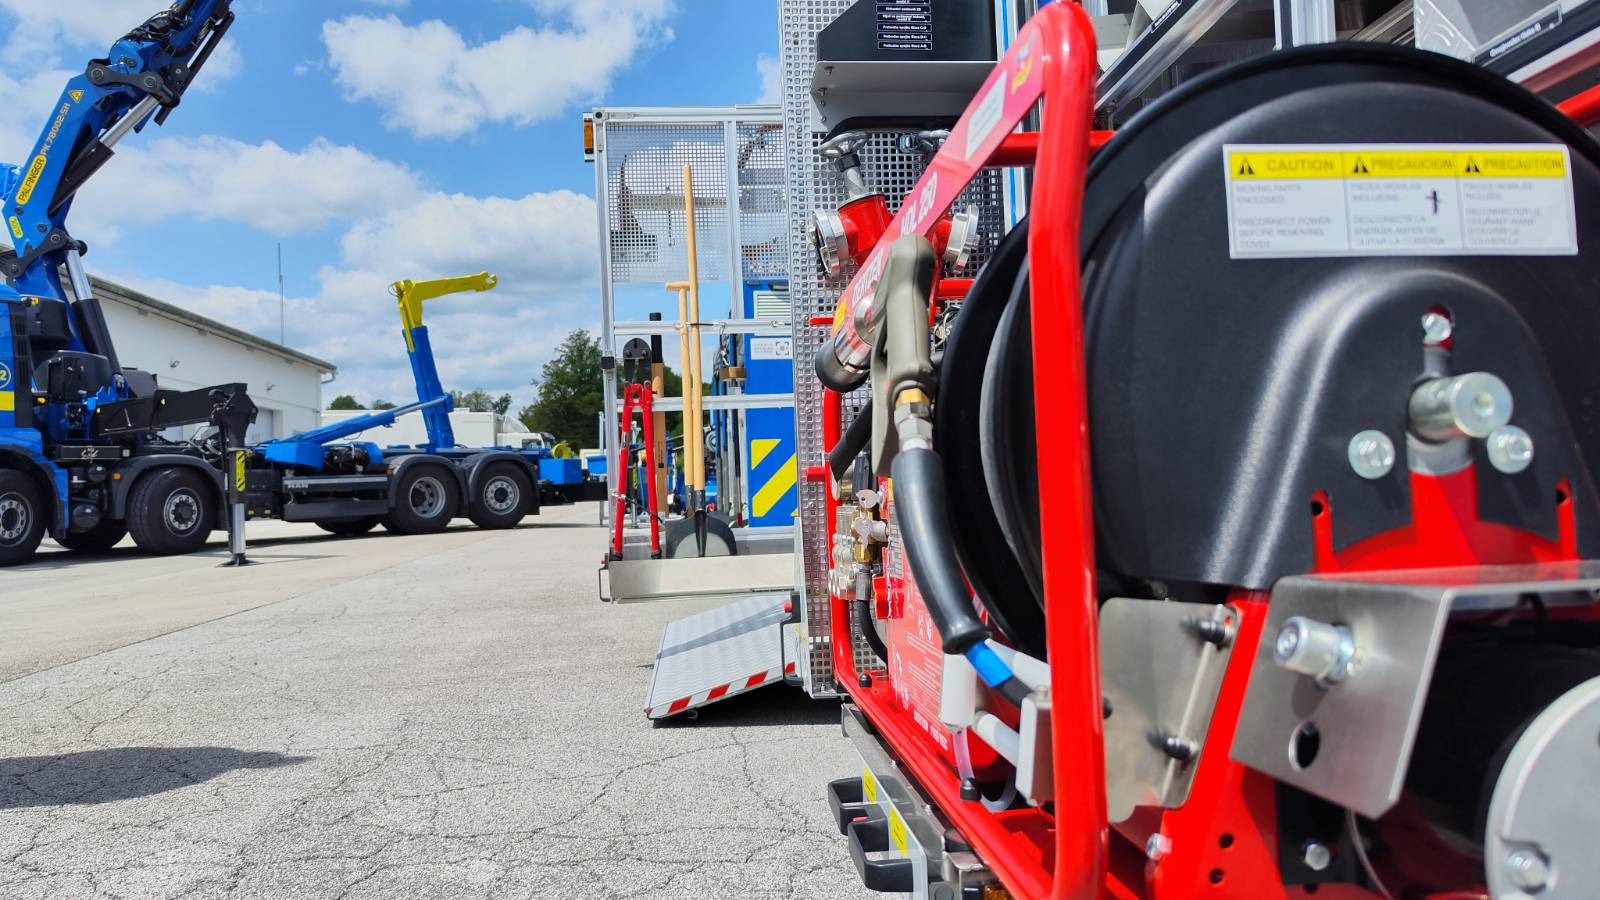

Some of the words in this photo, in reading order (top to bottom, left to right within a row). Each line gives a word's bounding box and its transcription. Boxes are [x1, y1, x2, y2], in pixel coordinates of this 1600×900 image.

[40, 143, 51, 156] PK
[1266, 158, 1334, 172] CAUTION
[18, 157, 44, 202] PALFINGER
